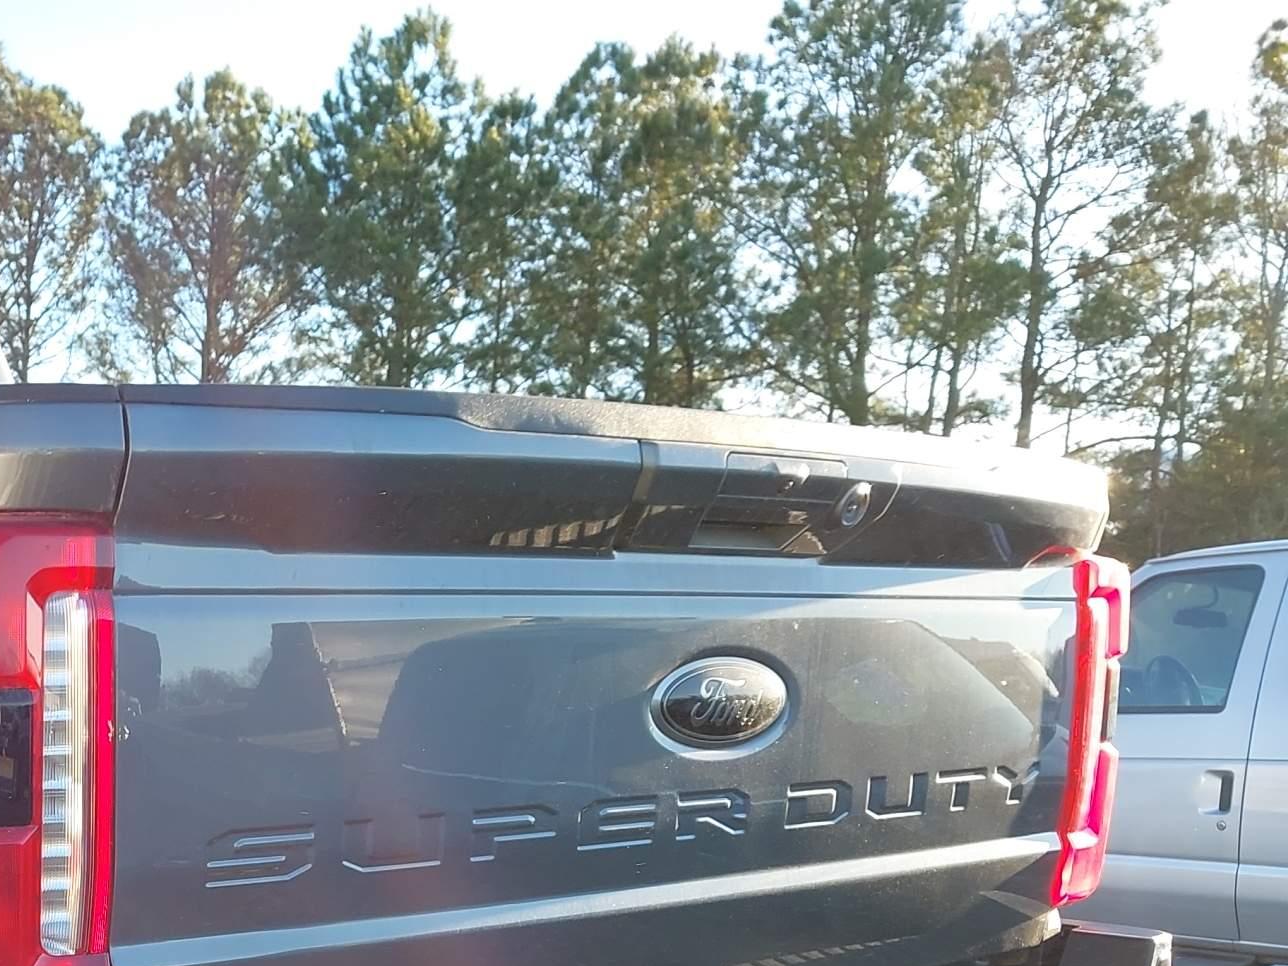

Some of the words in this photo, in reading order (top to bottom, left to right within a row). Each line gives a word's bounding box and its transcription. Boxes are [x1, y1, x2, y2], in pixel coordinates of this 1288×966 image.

[690, 676, 763, 727] Ford
[205, 787, 753, 888] SUPER
[783, 760, 1041, 831] DUTY
